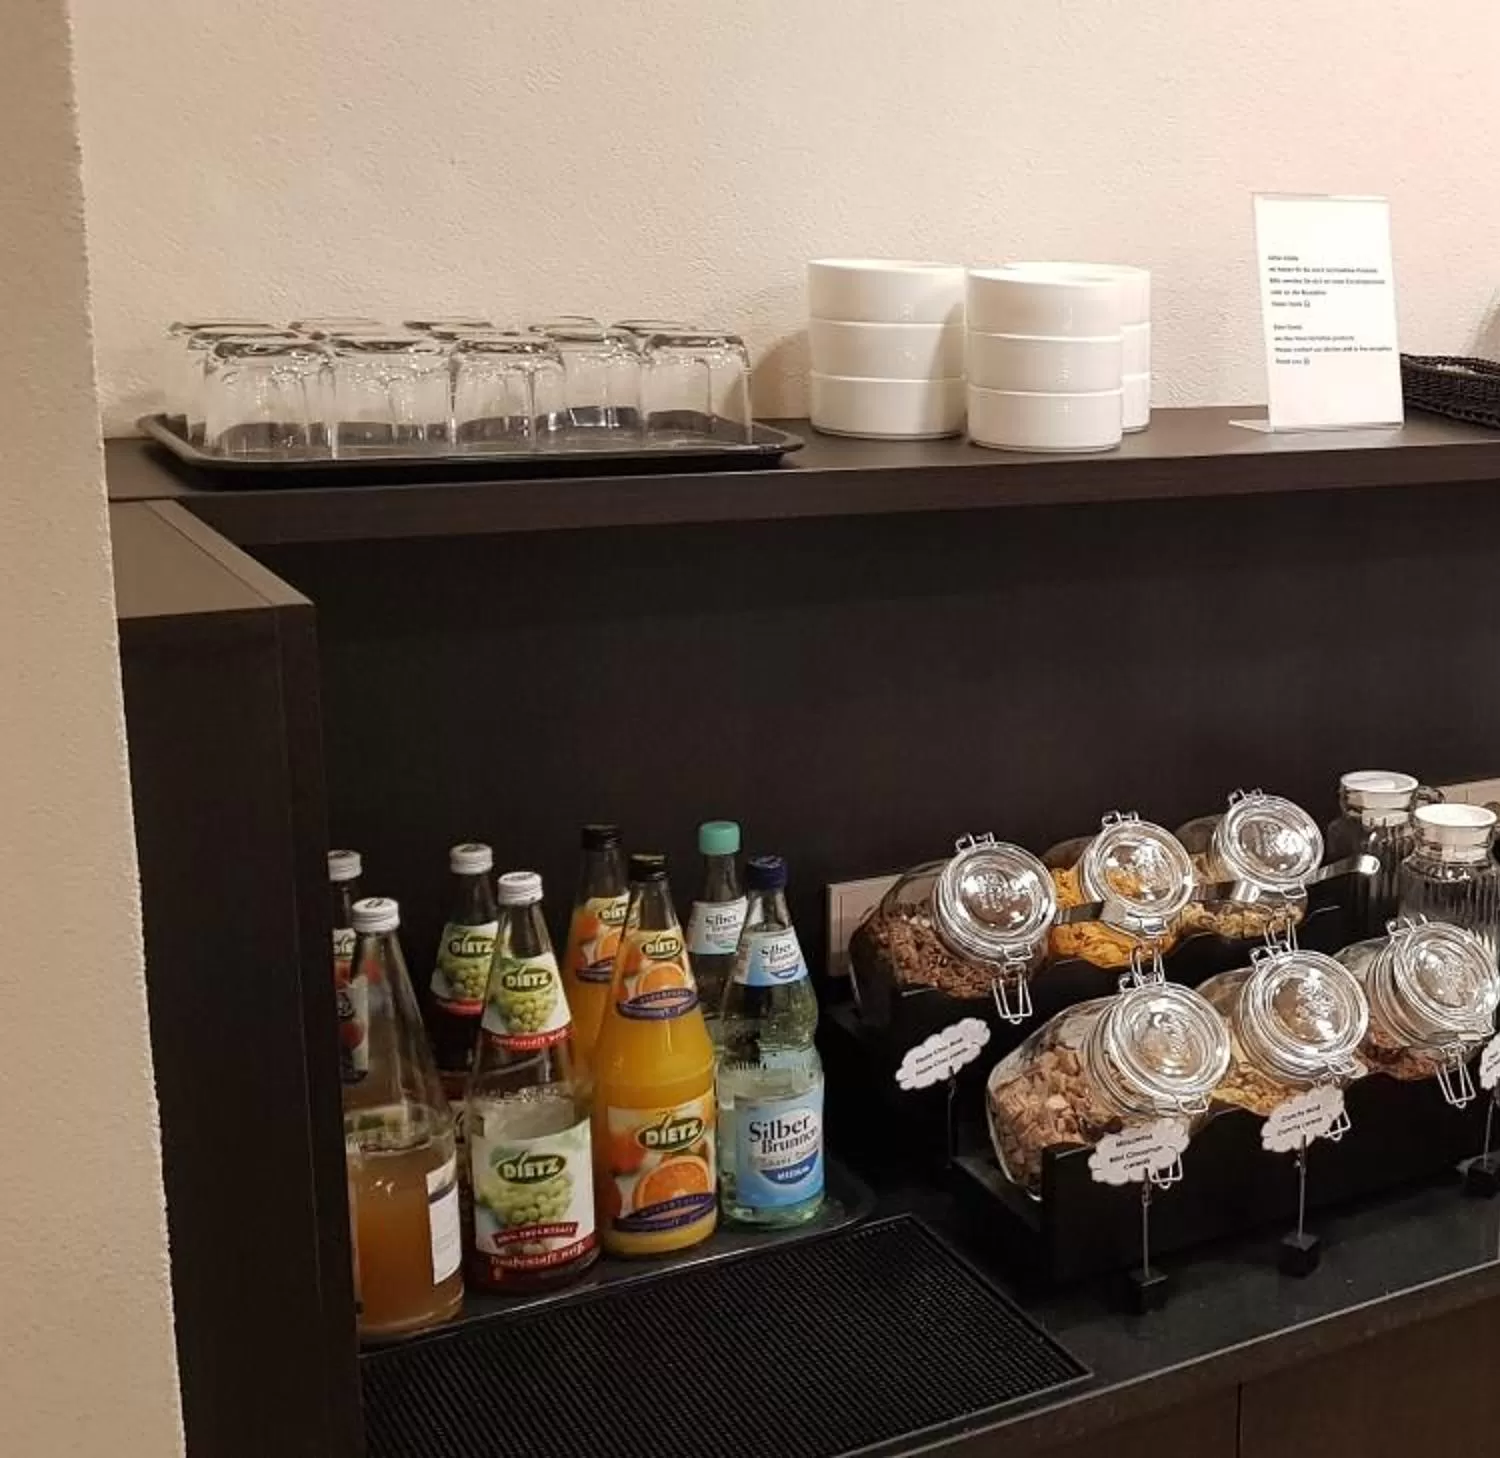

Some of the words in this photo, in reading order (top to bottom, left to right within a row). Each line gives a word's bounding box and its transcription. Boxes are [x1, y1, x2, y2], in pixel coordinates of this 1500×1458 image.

[506, 968, 548, 988] DIETZ
[645, 1118, 700, 1146] DIETZ
[749, 1115, 811, 1142] Silber
[502, 1155, 560, 1180] DIETZ
